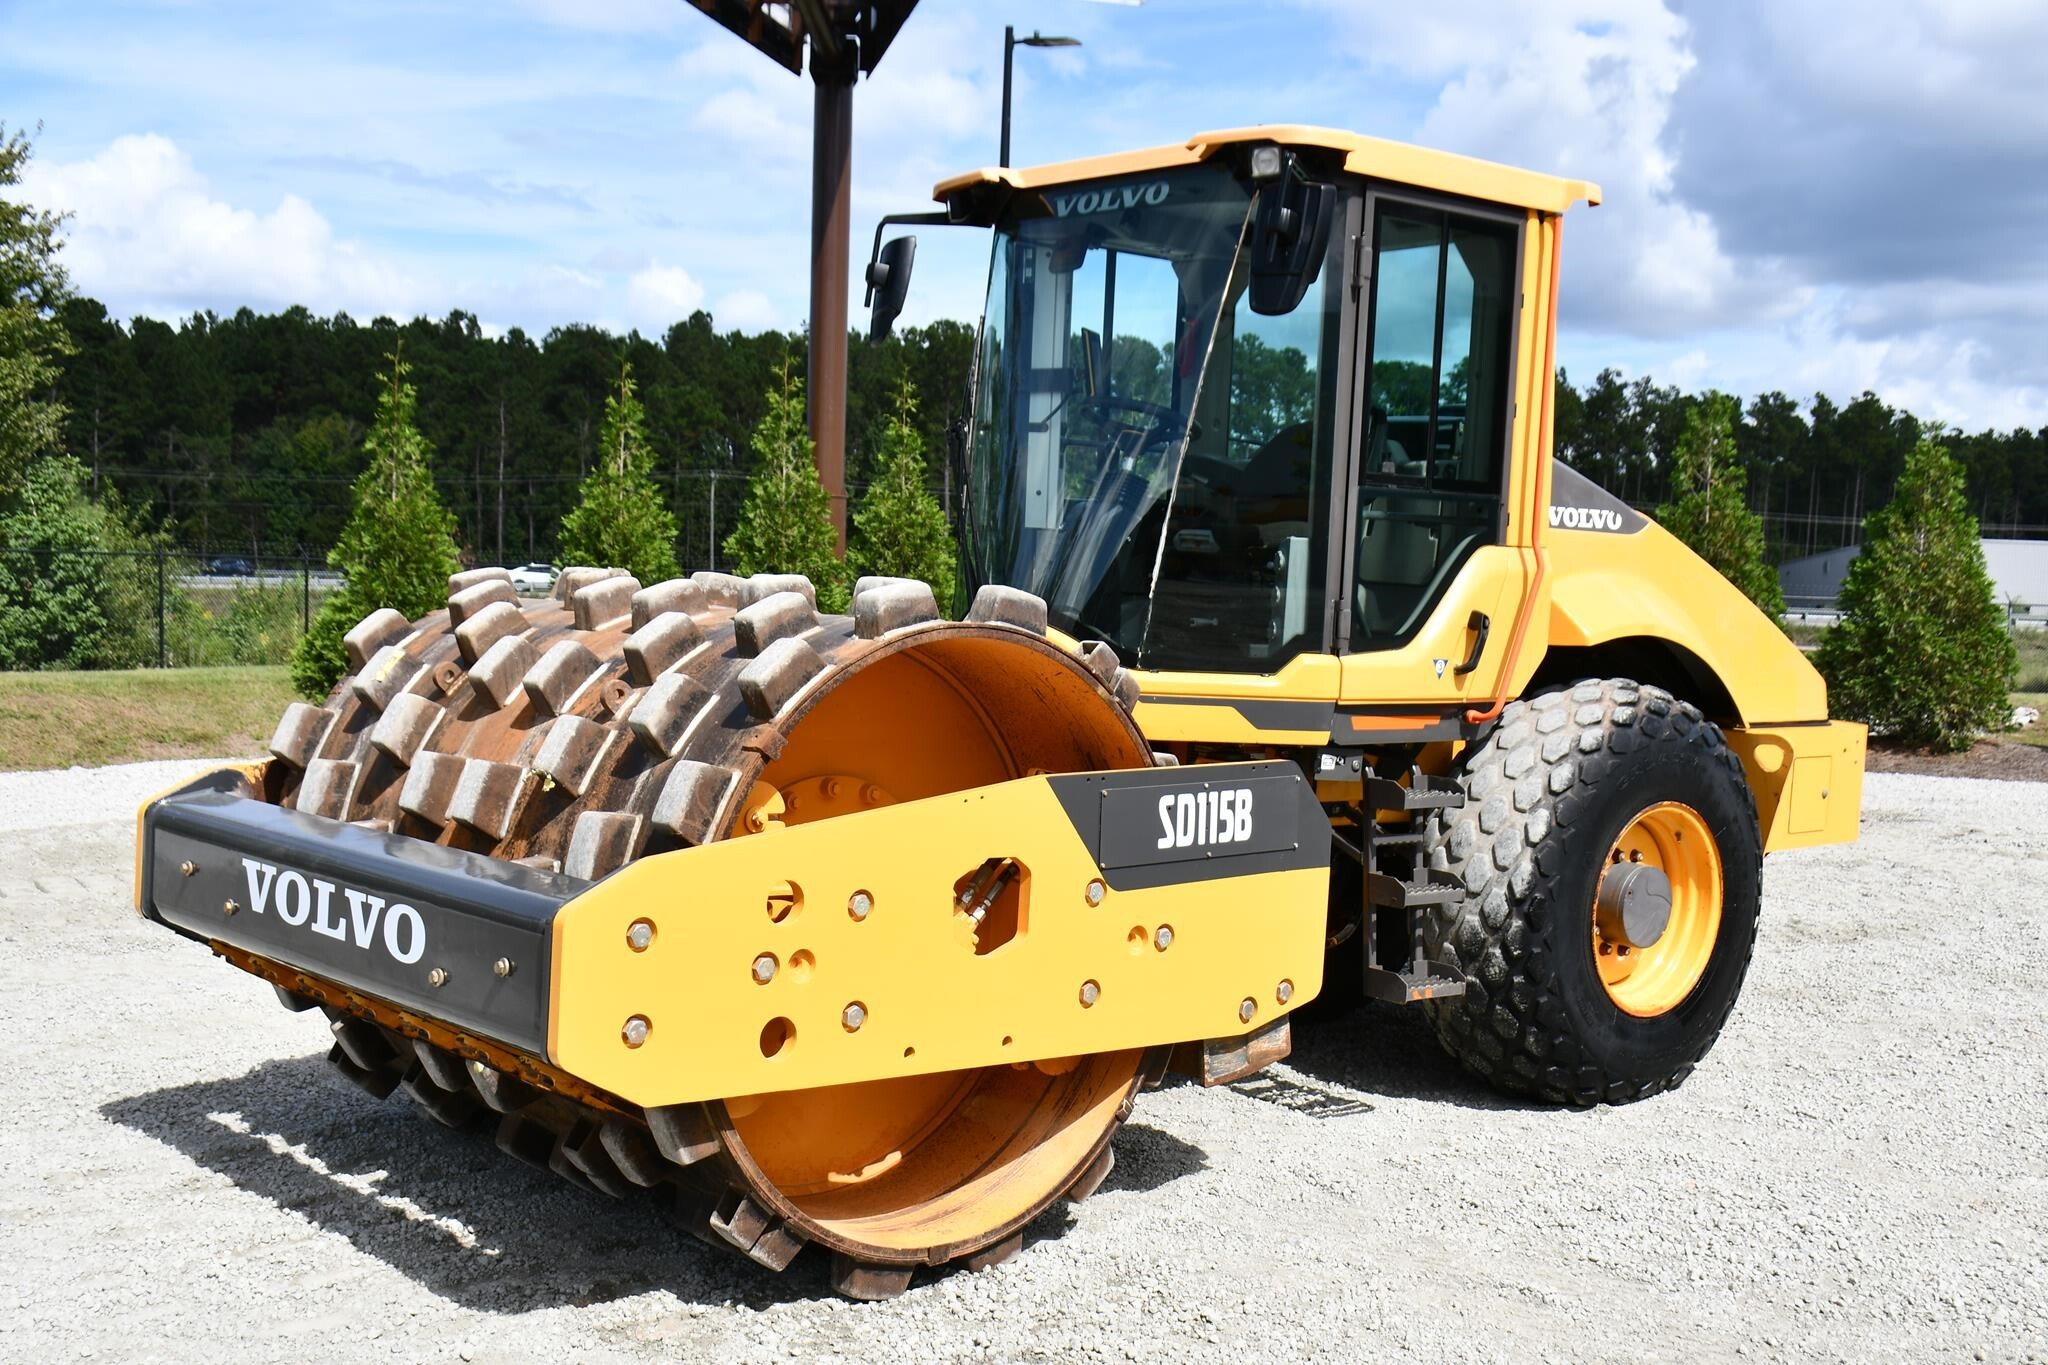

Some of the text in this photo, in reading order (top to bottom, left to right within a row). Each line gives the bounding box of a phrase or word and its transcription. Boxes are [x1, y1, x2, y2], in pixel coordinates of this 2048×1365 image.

[1054, 180, 1170, 218] VOLVO
[1549, 506, 1622, 530] VOLVO
[1157, 788, 1253, 850] SD115B
[242, 857, 426, 965] VOLVO
